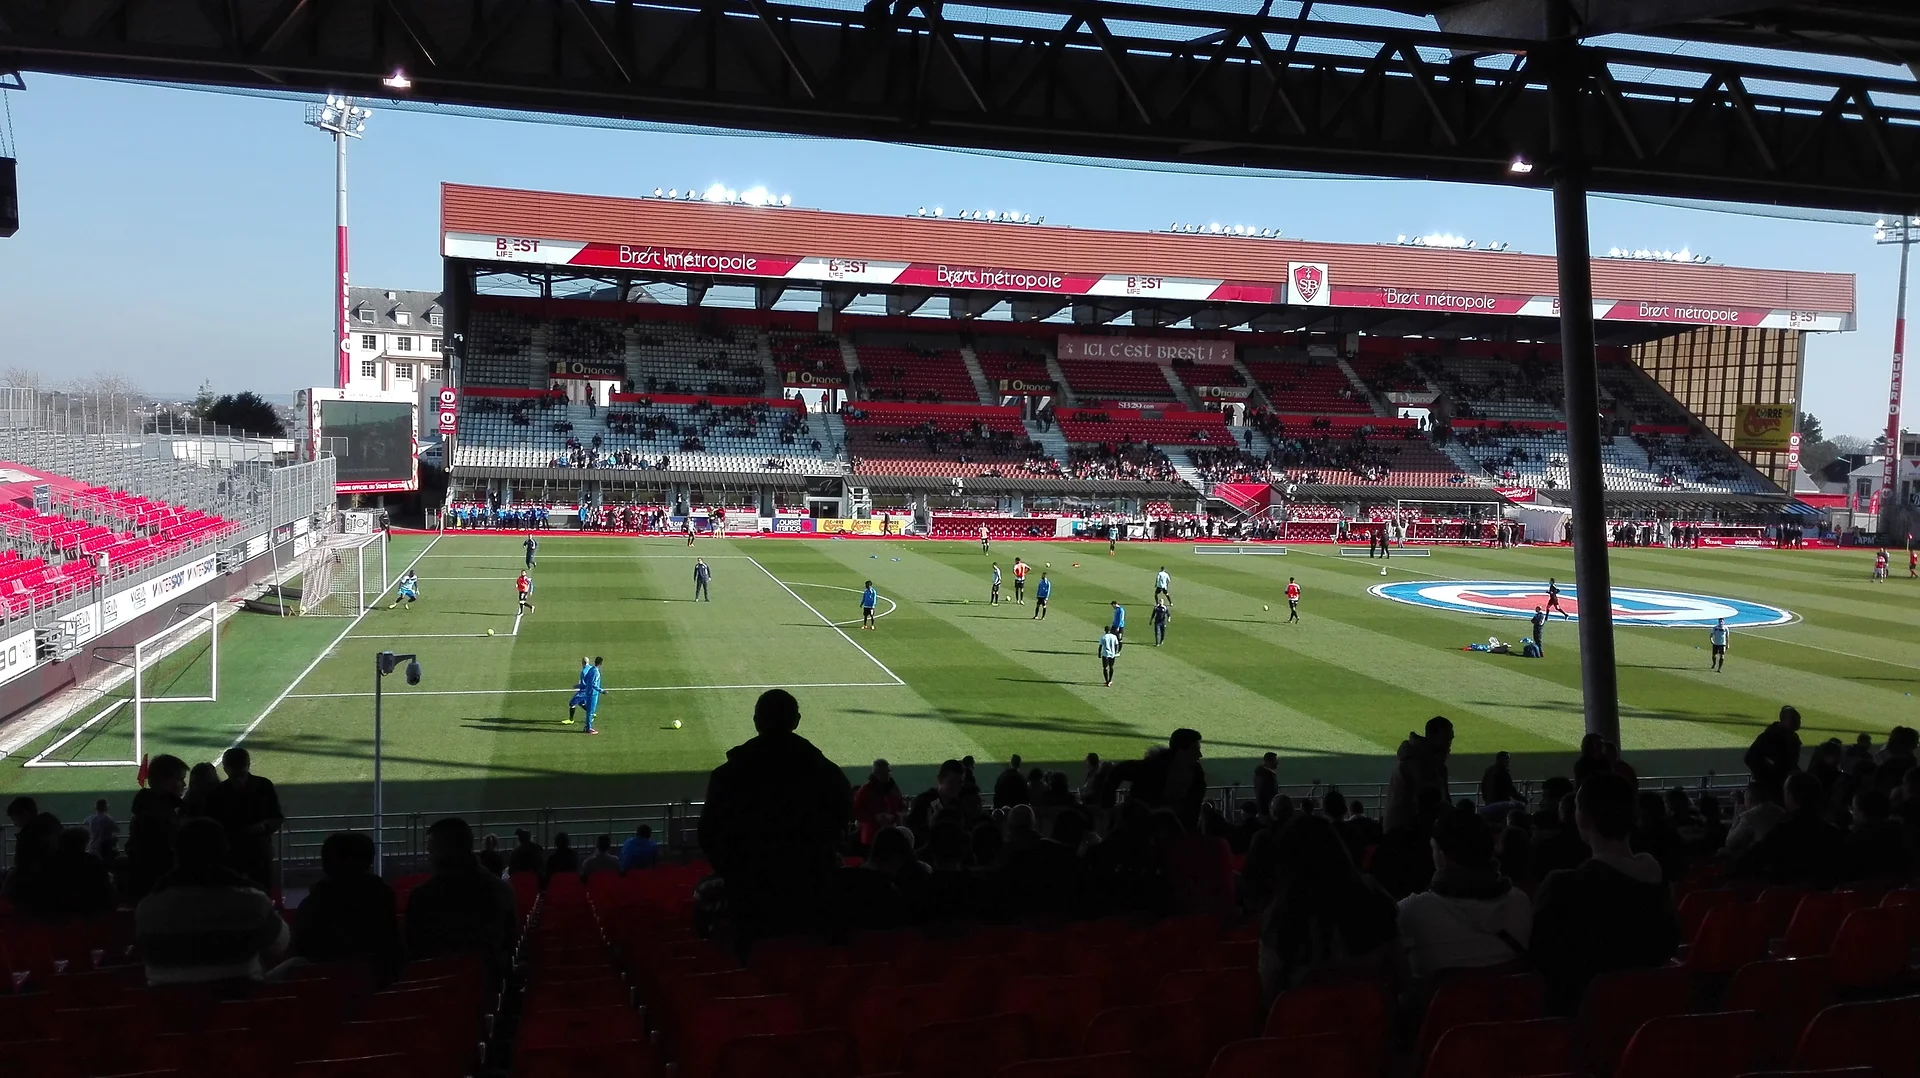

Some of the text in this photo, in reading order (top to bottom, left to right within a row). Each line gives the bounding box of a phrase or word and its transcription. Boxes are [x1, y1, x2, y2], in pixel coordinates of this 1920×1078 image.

[619, 245, 757, 272] Brest métropole
[937, 265, 1062, 290] Brest métropole
[1387, 288, 1496, 310] Brest métropole
[1639, 302, 1739, 322] Brest métropole
[1083, 343, 1106, 357] ICI,
[1157, 345, 1206, 361] BREST
[1890, 353, 1901, 400] SUPER
[1883, 438, 1895, 484] SUPER
[776, 524, 802, 532] france
[779, 518, 801, 526] ouest
